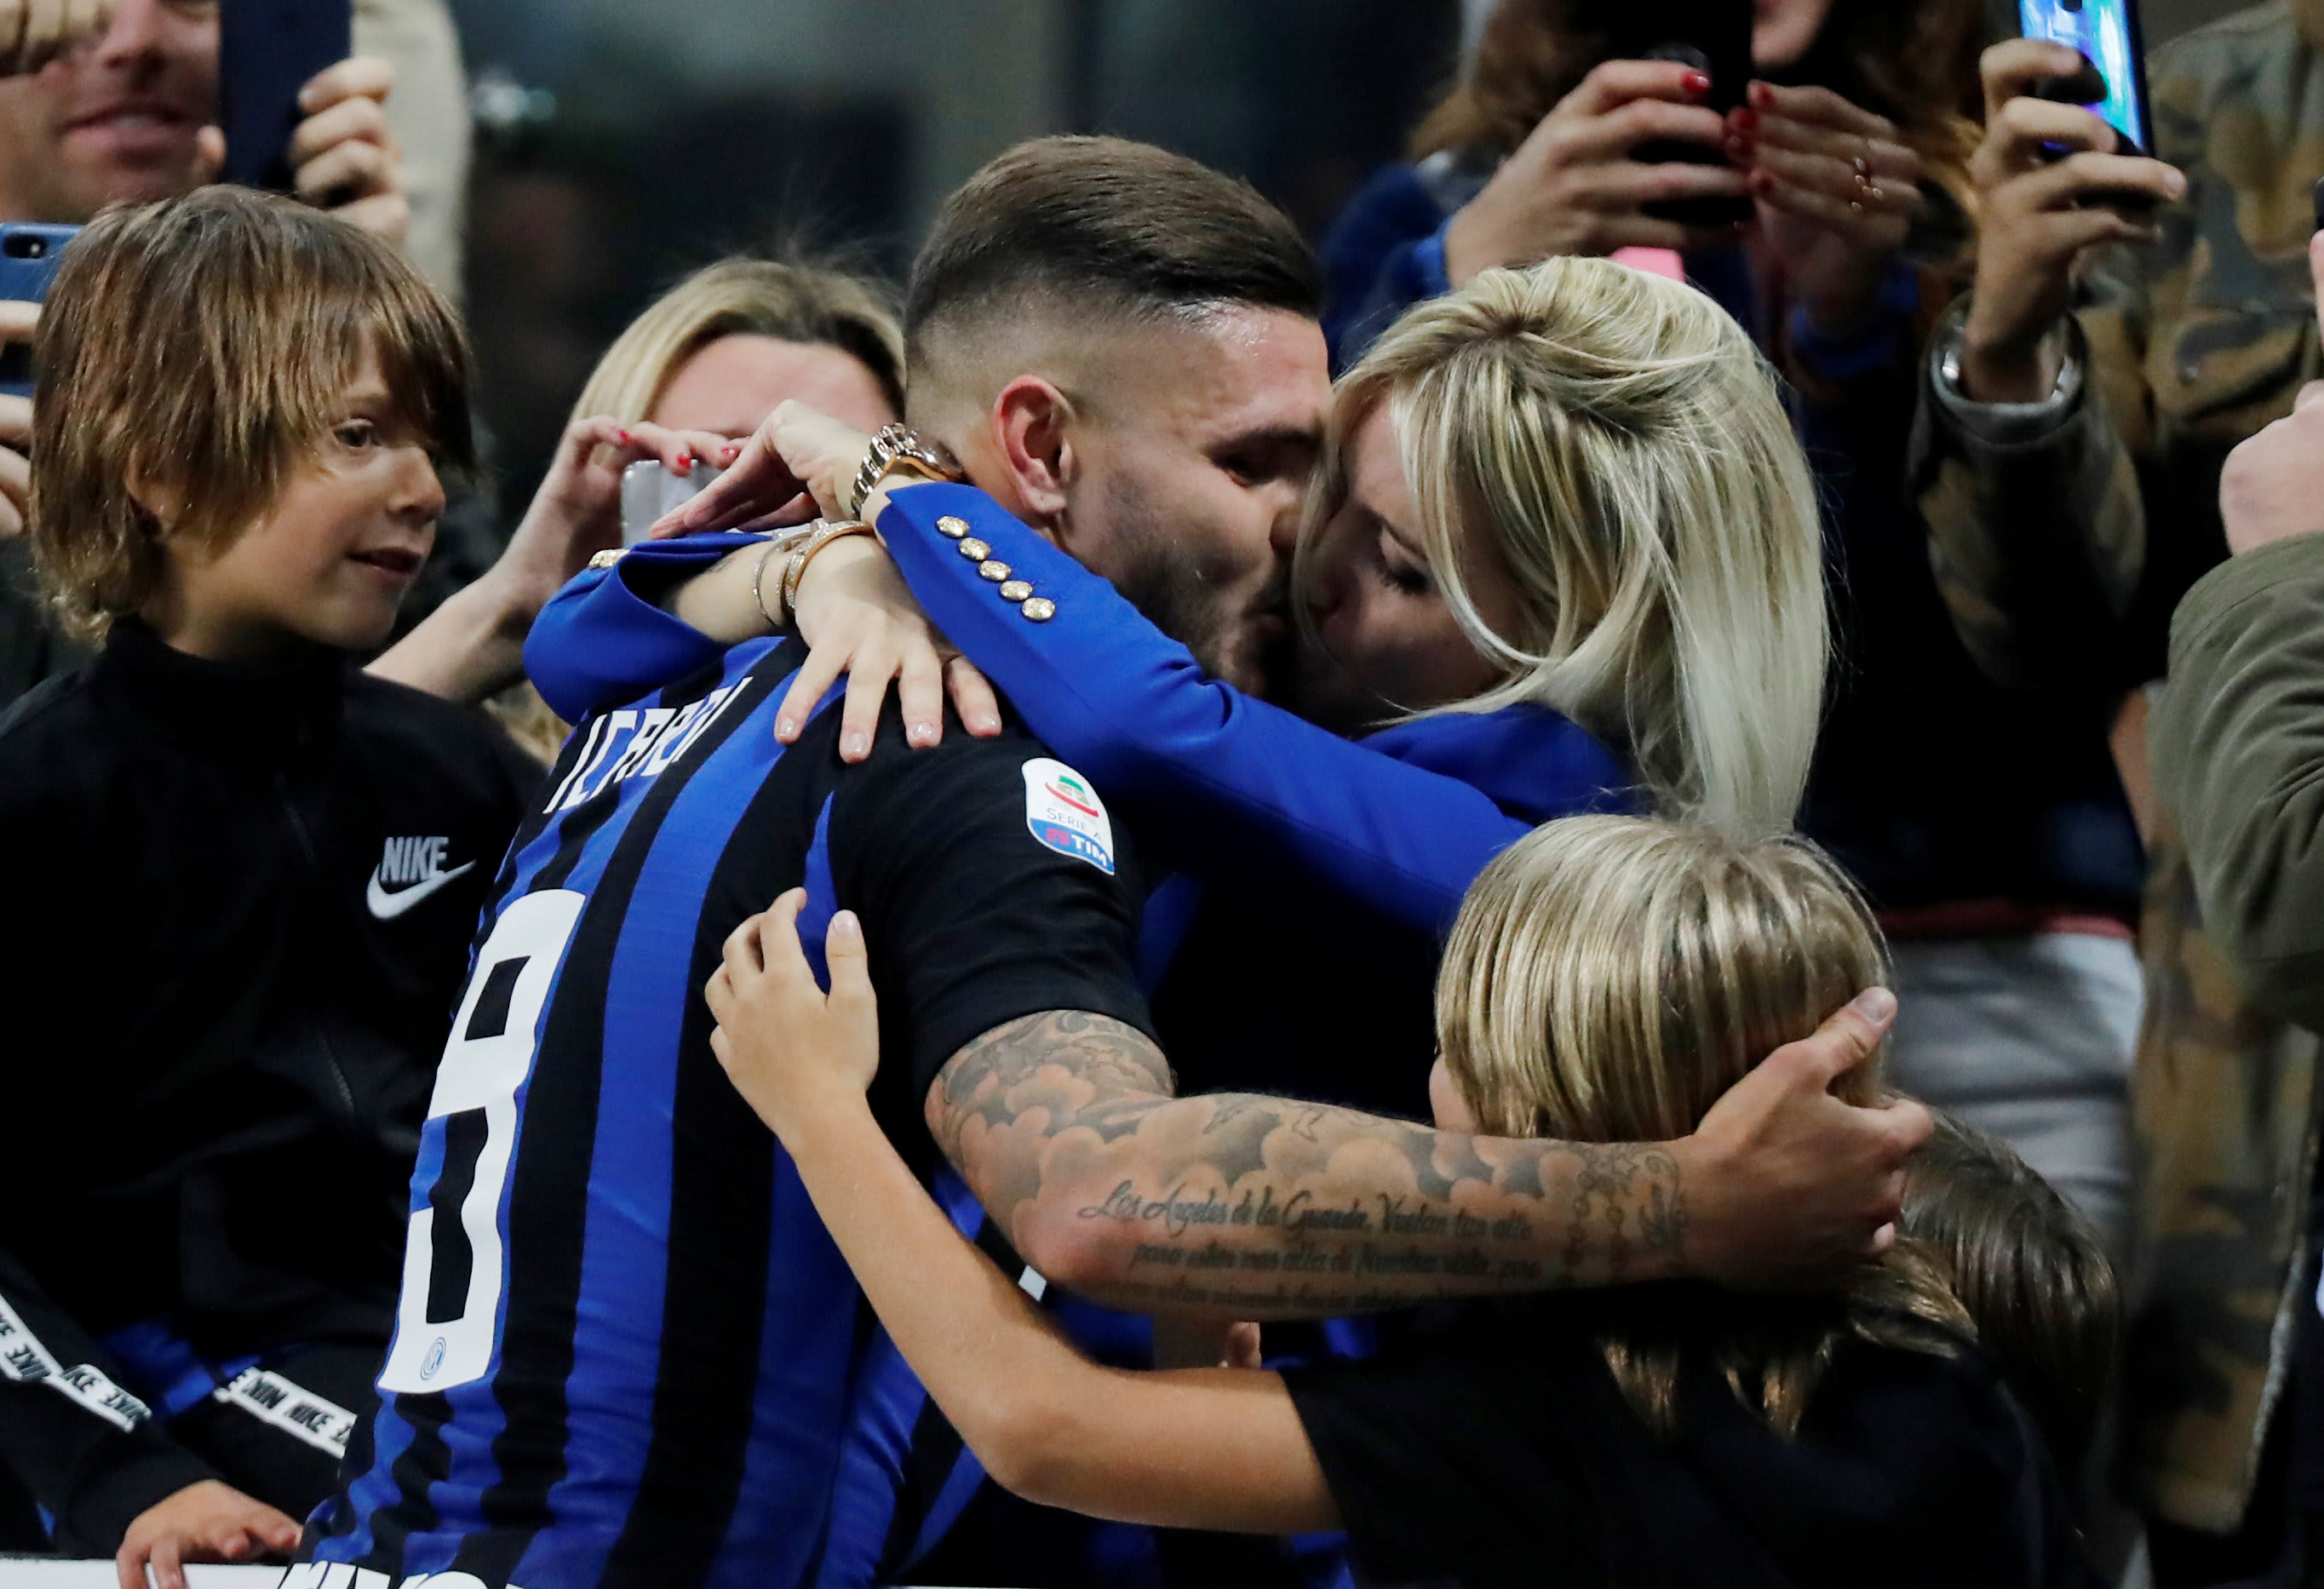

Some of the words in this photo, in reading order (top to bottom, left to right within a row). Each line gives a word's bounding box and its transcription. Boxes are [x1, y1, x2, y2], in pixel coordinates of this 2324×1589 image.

[1047, 808, 1087, 831] SERIE
[381, 835, 450, 882] NIKE
[1070, 834, 1108, 867] TIM
[376, 888, 586, 1394] 9
